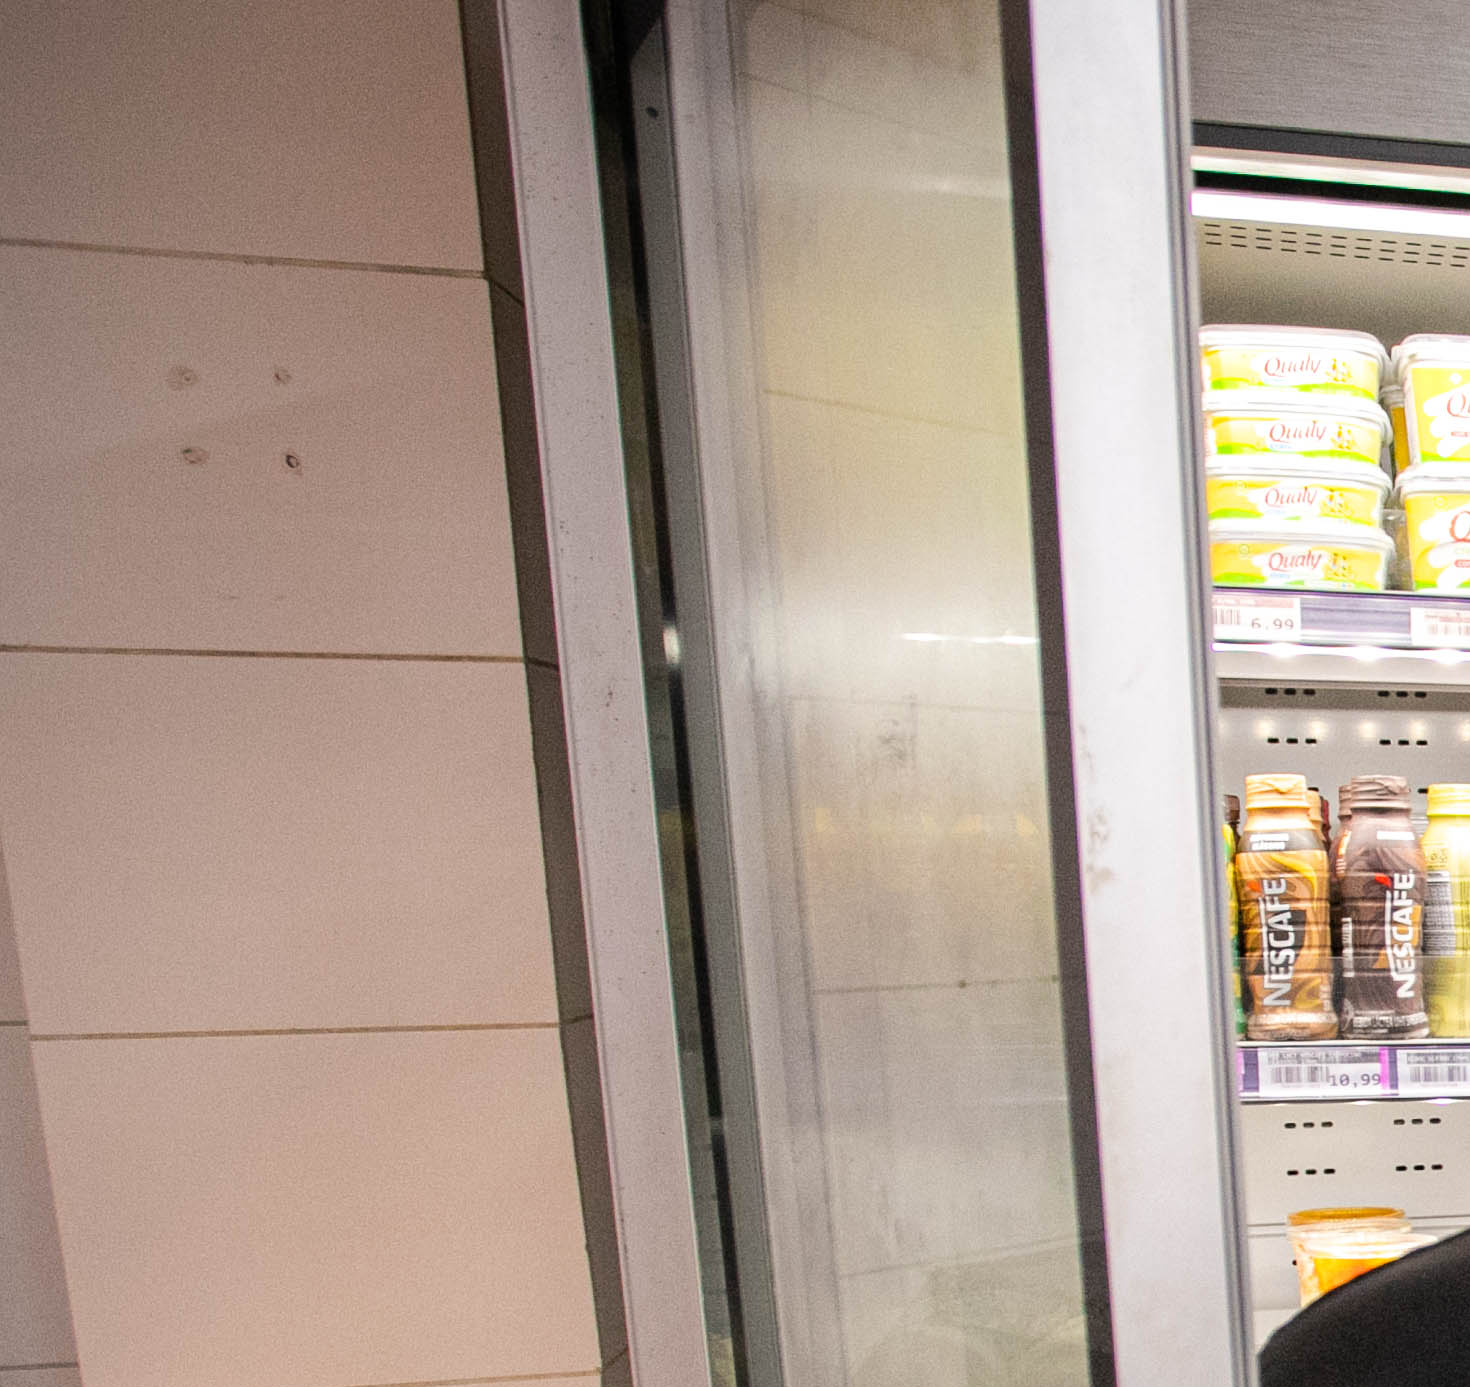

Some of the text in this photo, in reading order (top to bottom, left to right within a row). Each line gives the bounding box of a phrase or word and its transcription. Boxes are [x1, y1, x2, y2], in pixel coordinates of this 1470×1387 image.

[1264, 485, 1317, 508] Qualy
[1267, 549, 1322, 571] Qualy
[1328, 1073, 1381, 1089] 10,99
